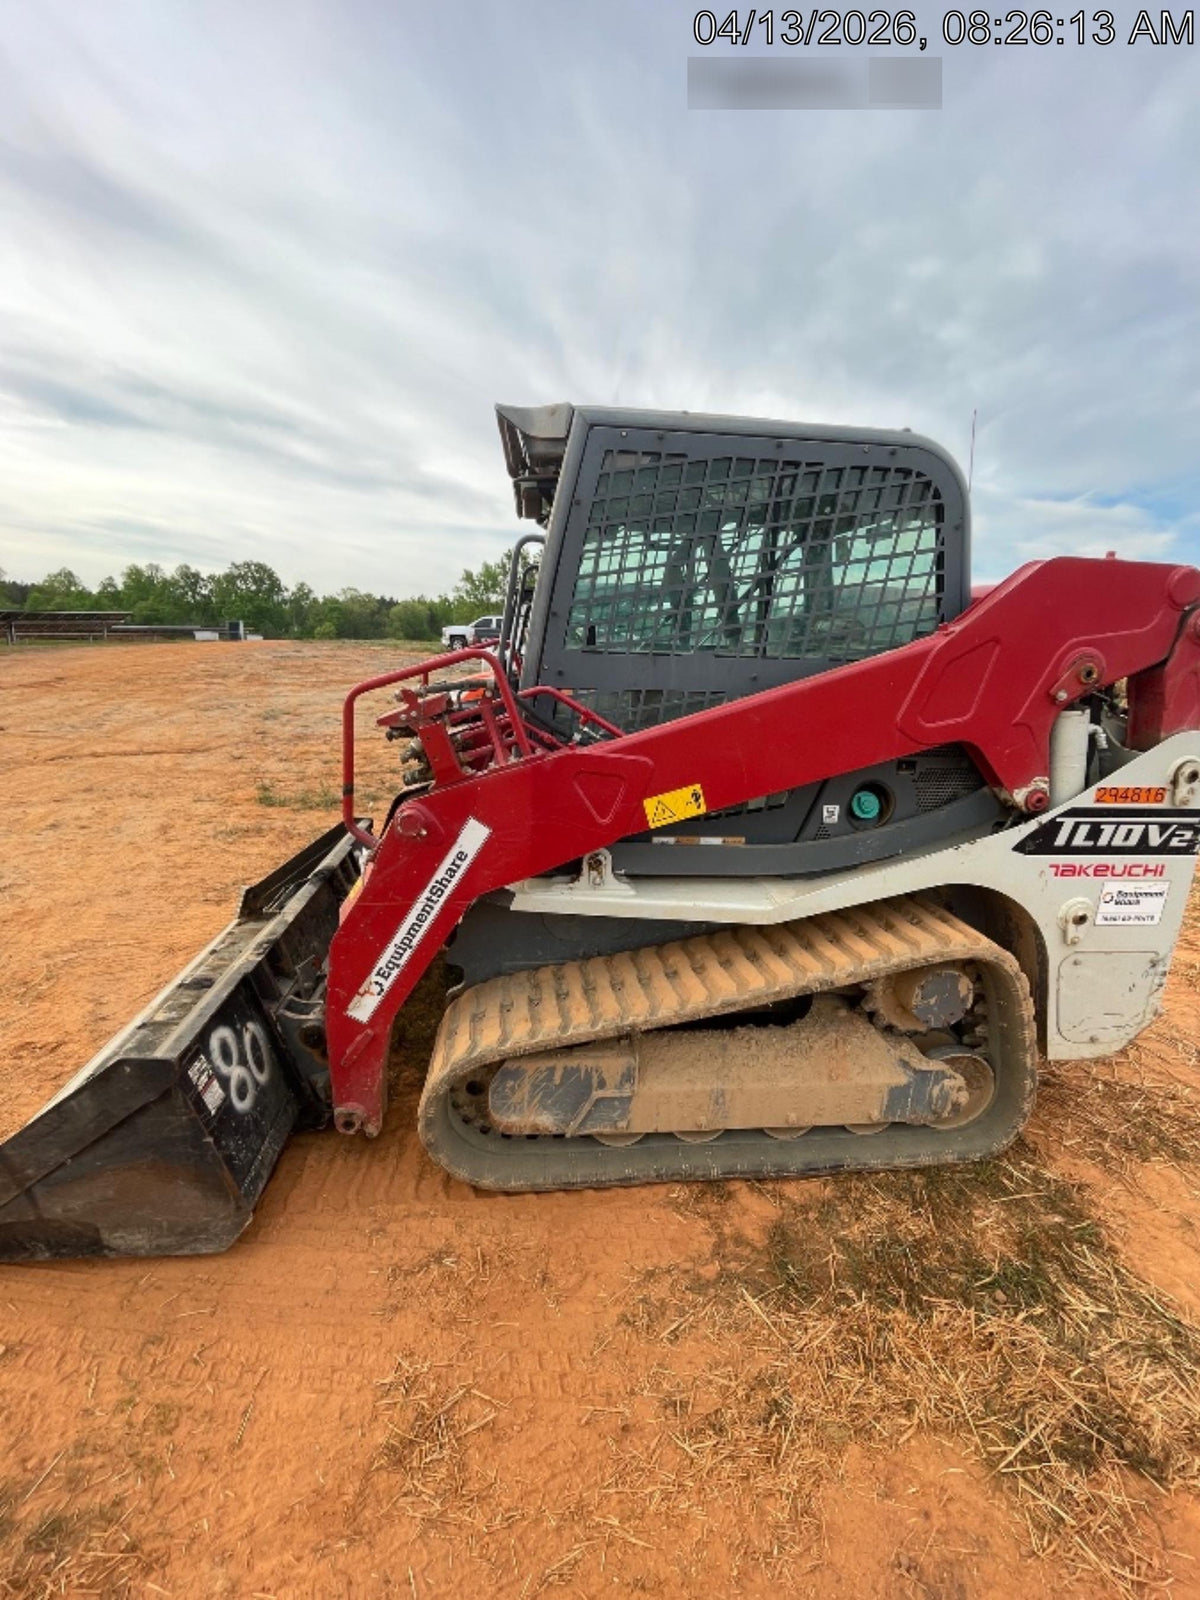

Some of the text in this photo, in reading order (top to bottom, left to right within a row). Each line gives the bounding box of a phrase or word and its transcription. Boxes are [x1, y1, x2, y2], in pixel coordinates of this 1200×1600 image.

[1094, 786, 1167, 803] 294816
[375, 849, 469, 982] EquipmentShare
[208, 1021, 270, 1114] 80
